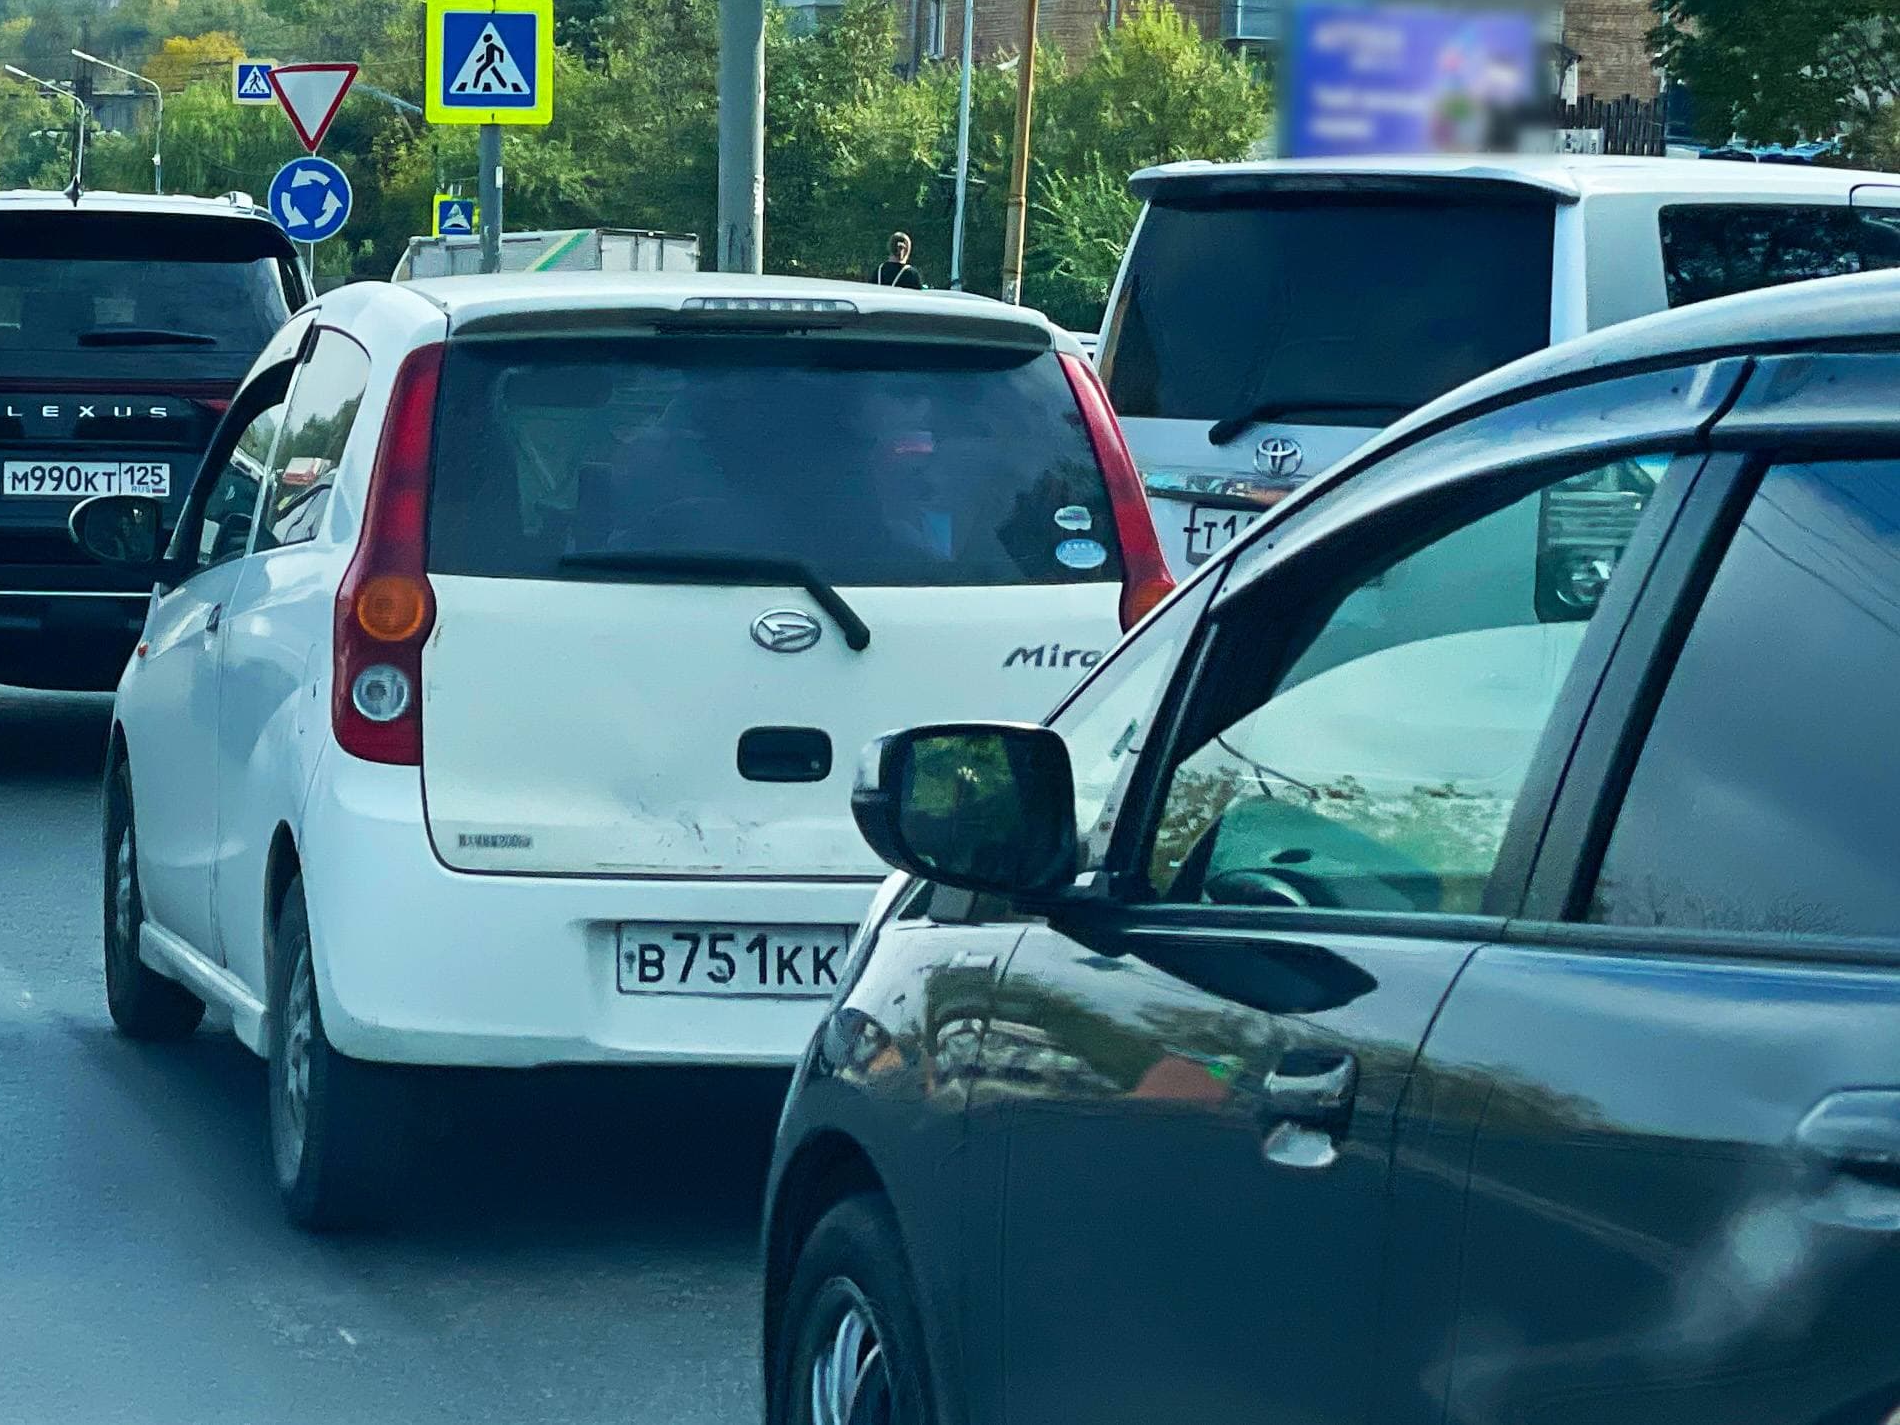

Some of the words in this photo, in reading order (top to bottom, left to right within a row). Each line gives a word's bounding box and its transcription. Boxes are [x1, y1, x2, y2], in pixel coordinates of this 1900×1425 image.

[7, 405, 167, 418] LEXUS
[123, 466, 165, 486] 125
[131, 486, 151, 494] RUS
[1003, 643, 1102, 668] Mira
